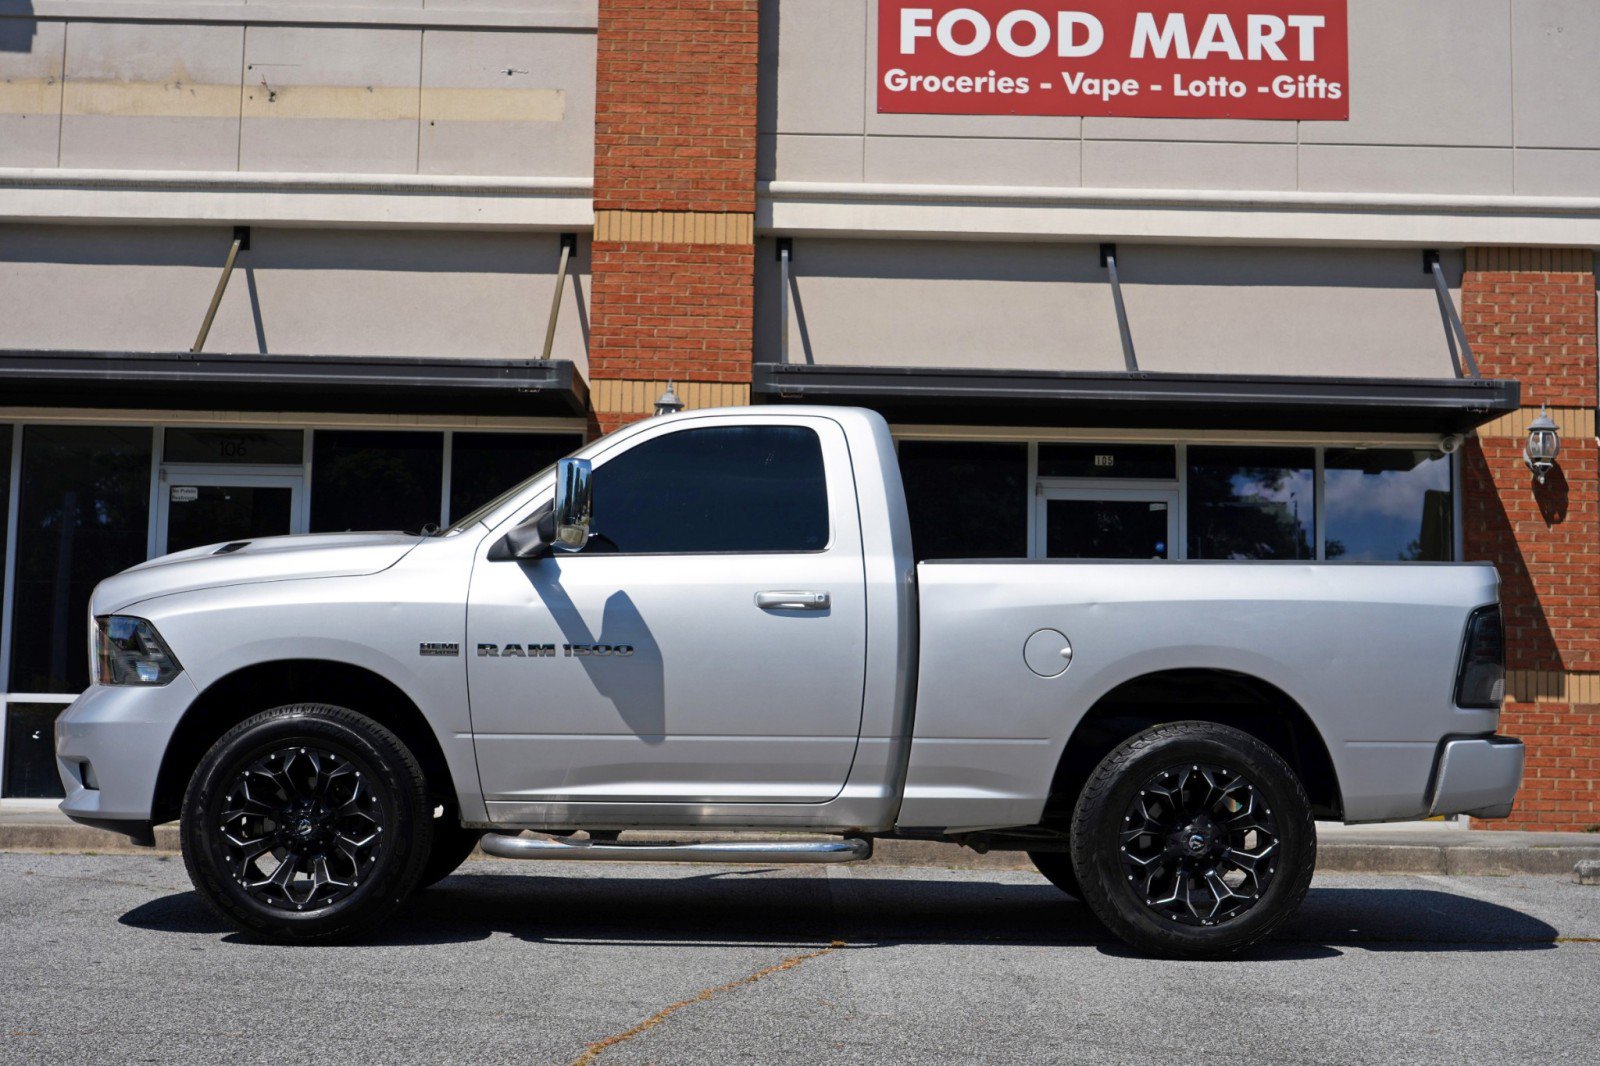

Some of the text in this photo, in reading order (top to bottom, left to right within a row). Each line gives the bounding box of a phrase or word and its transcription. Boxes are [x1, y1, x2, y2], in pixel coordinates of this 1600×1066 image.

[900, 8, 1325, 61] FOOD MART
[884, 69, 1029, 93] Groceries
[1062, 72, 1139, 101] Vape
[1174, 74, 1246, 98] Lotto
[220, 440, 247, 456] 106
[1096, 456, 1113, 465] 105
[477, 643, 634, 657] RAM 1500
